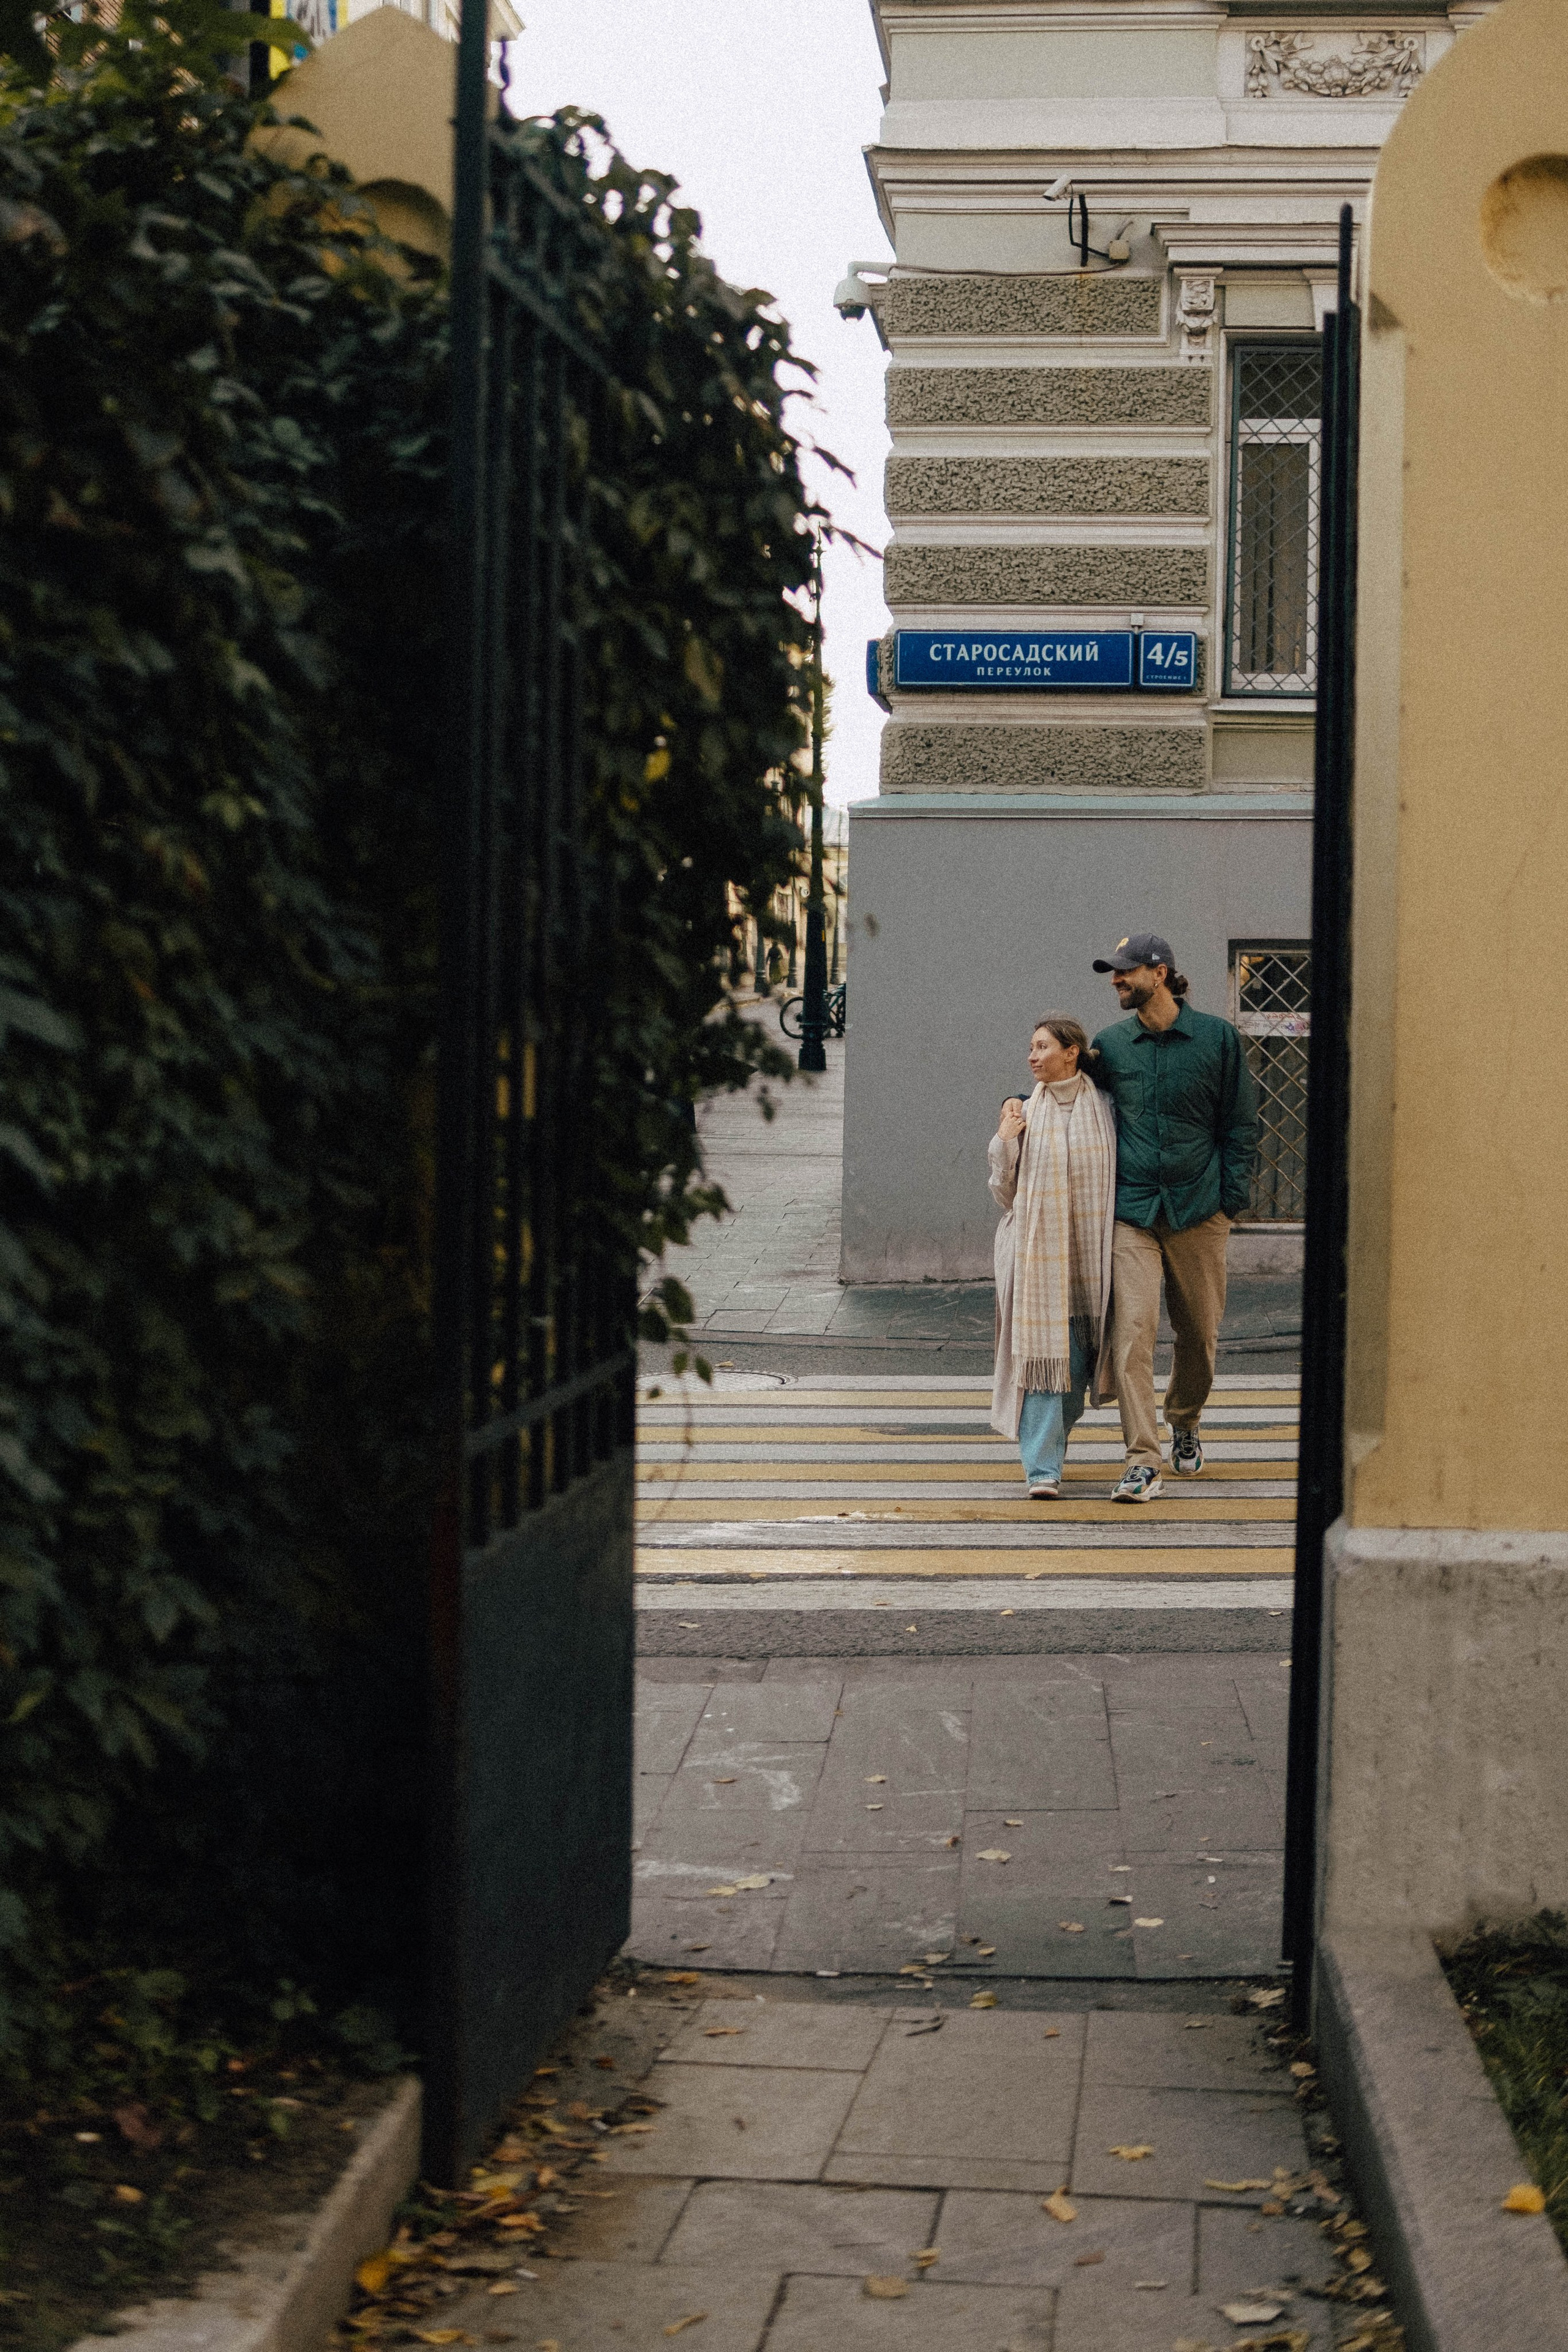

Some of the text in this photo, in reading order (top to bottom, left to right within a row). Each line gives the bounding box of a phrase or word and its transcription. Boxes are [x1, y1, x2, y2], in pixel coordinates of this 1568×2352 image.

[929, 641, 1098, 663] СТАРОСАДСКИЙ
[1147, 642, 1188, 668] 4/5
[977, 667, 1052, 676] ПЕРЕУЛОК
